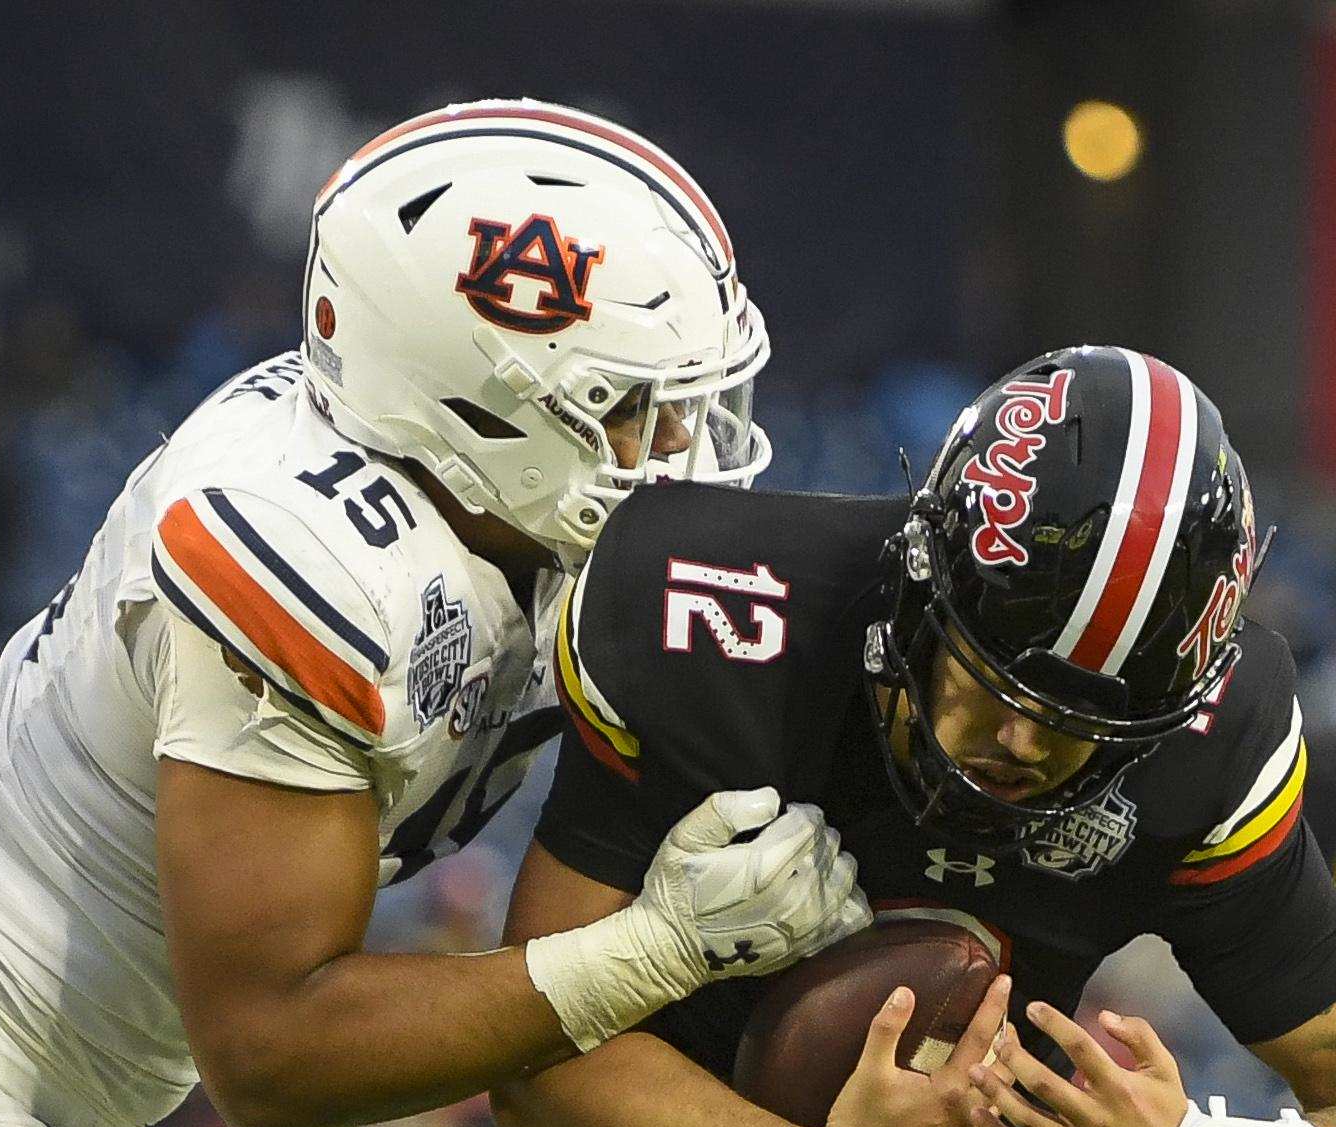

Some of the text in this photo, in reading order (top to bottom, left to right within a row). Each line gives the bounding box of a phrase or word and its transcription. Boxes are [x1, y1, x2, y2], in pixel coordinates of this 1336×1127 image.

[537, 393, 601, 451] AUBURN
[962, 369, 1075, 566] Terps
[294, 451, 417, 550] 15
[441, 633, 468, 667] CITY
[662, 555, 792, 664] 12
